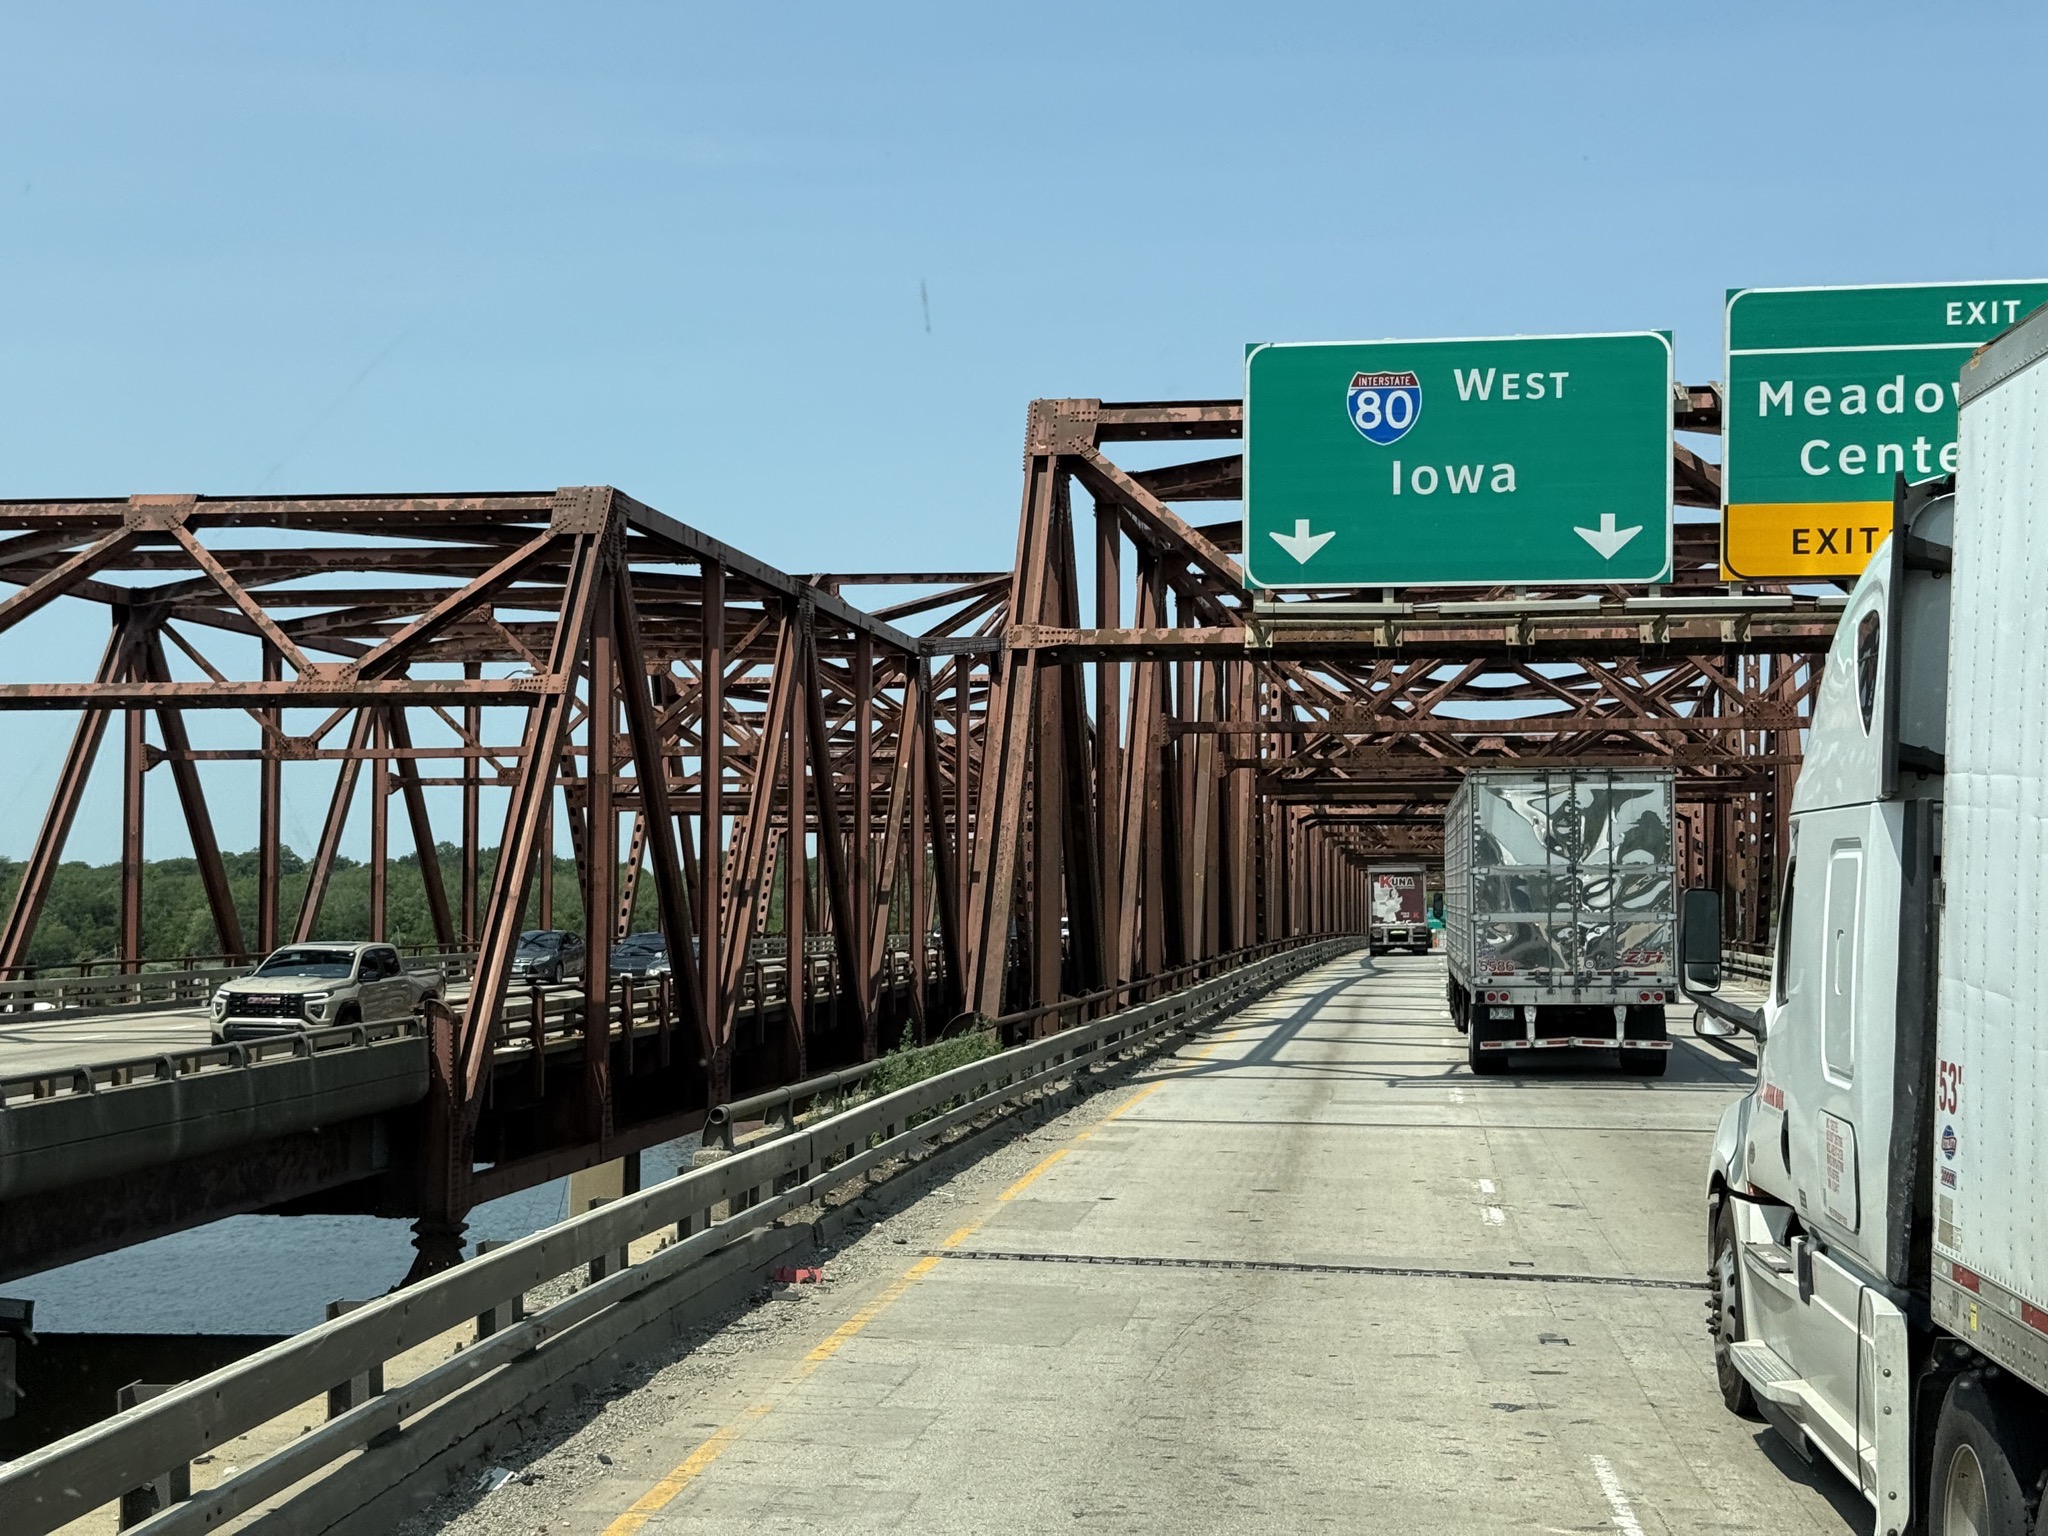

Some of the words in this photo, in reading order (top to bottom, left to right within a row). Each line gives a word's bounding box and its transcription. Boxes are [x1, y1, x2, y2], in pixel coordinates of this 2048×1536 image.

[1946, 300, 2021, 325] EXIT
[1358, 376, 1411, 386] INTERSTATE
[1453, 367, 1569, 401] WEST
[1355, 390, 1413, 429] 80
[1392, 460, 1517, 495] Iowa
[1792, 527, 1880, 555] EXIT
[1379, 875, 1415, 888] KUNA
[1479, 960, 1515, 972] 5586
